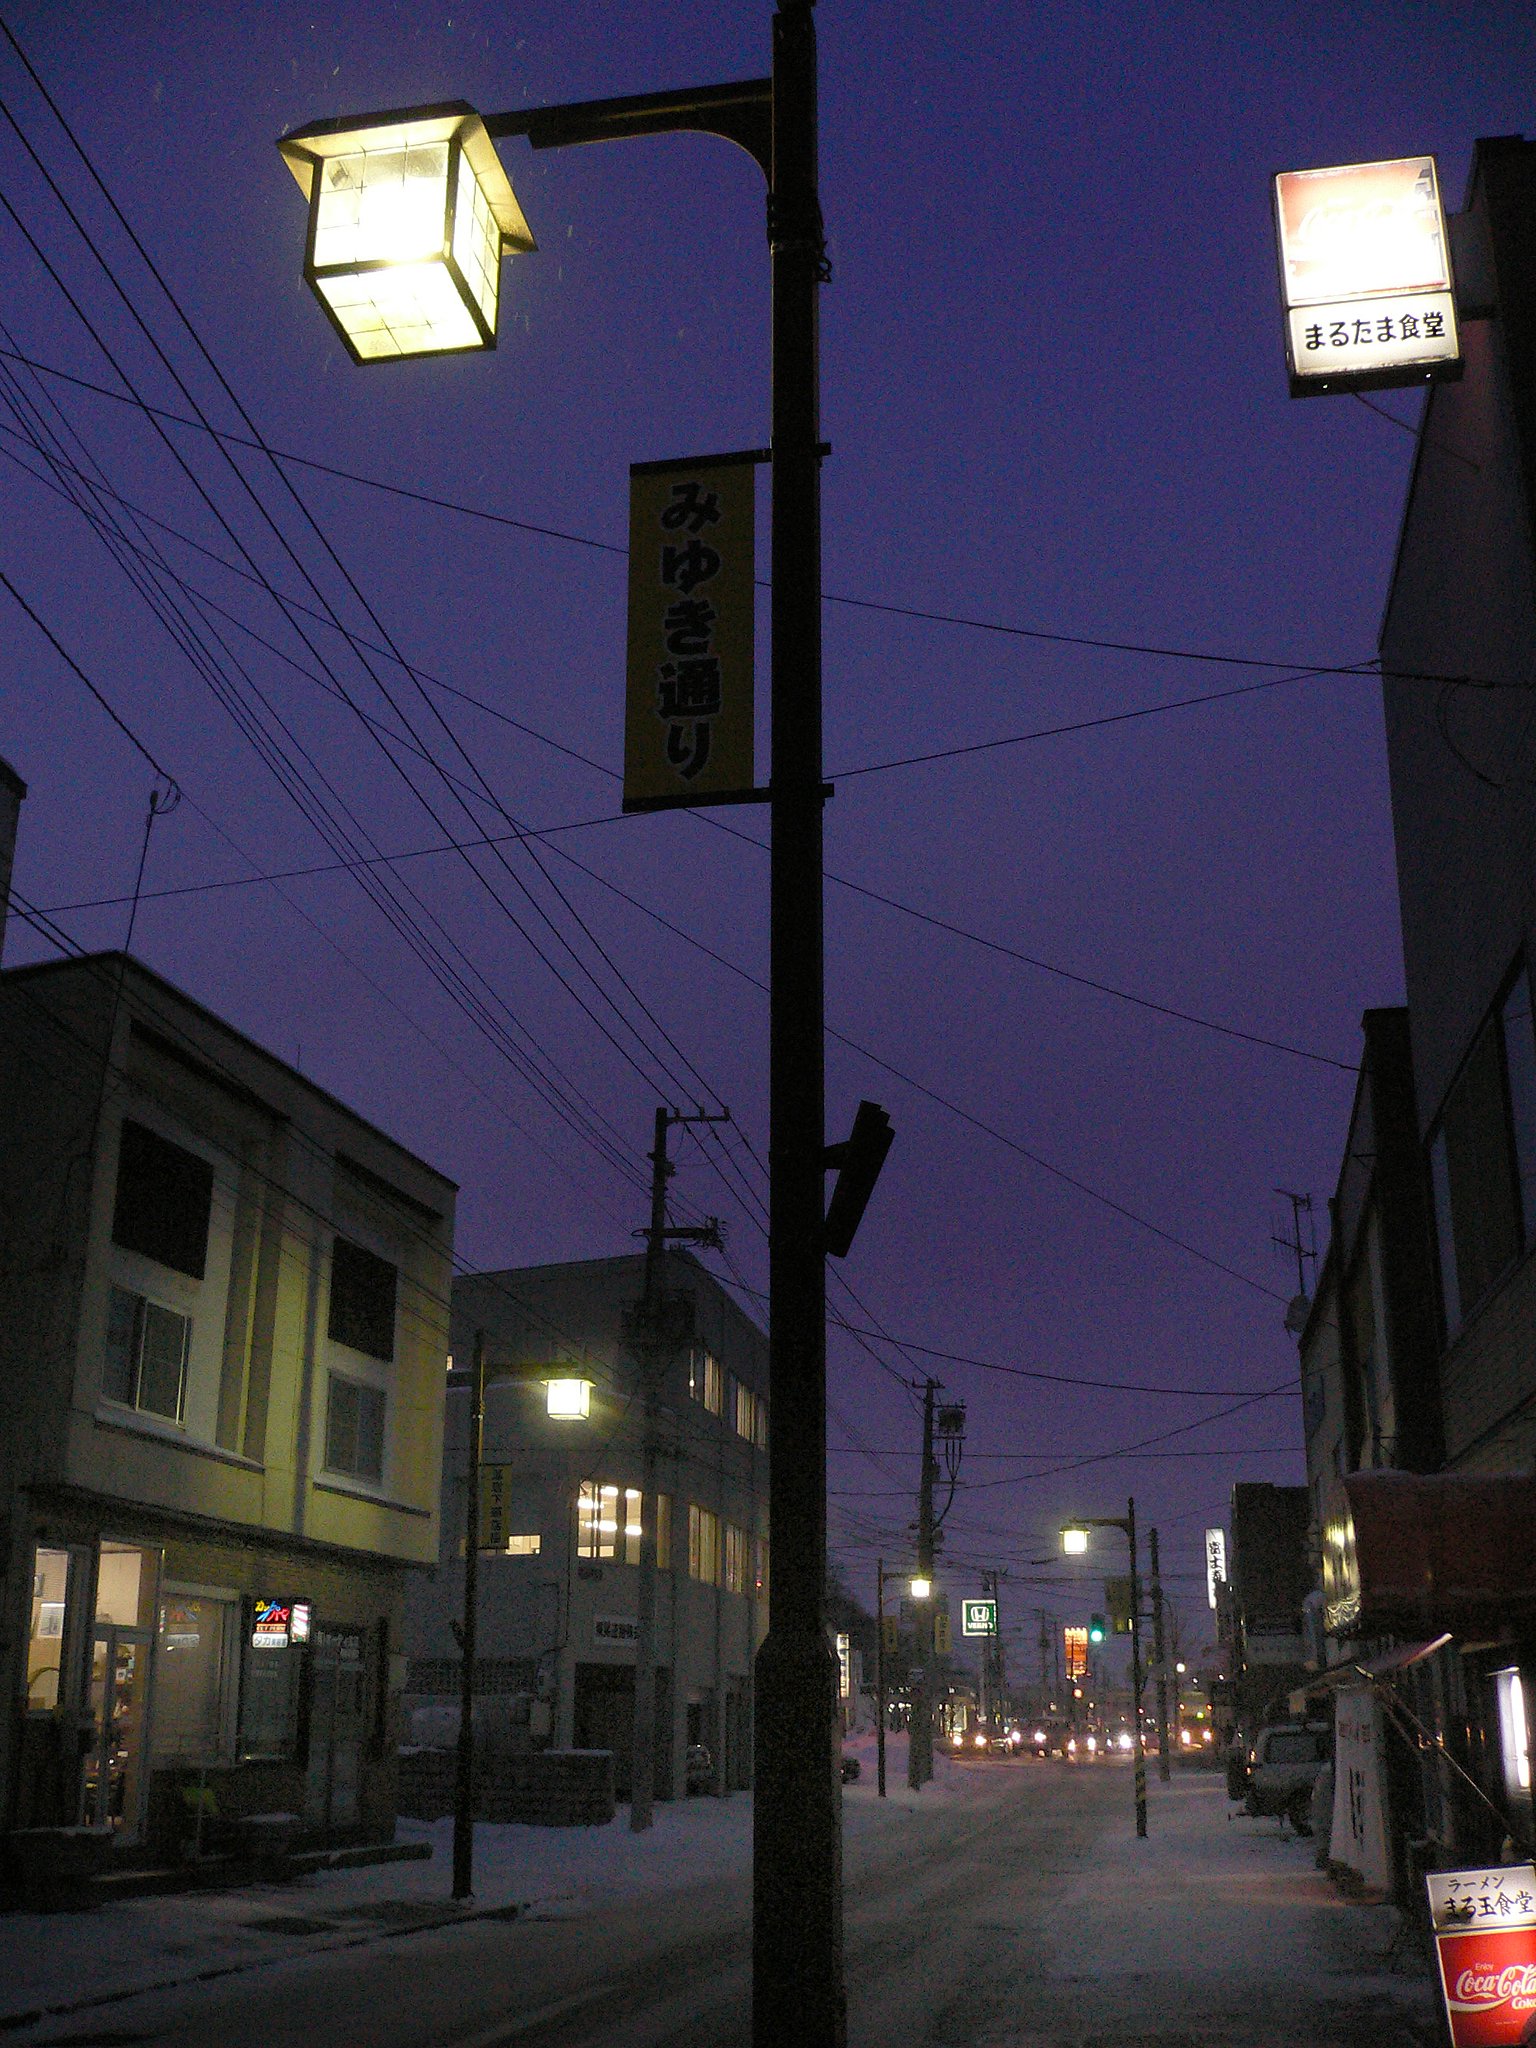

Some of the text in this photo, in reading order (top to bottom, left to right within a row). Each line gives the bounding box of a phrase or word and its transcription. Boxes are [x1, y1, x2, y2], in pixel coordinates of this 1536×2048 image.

[1305, 311, 1445, 351] まるたま食堂
[657, 480, 722, 781] みゆき通り
[1448, 1876, 1504, 1893] ラーメン
[1444, 1890, 1534, 1918] まる玉食堂
[1456, 1963, 1536, 2000] Coca-Cola
[1475, 1962, 1494, 1971] Enjoy
